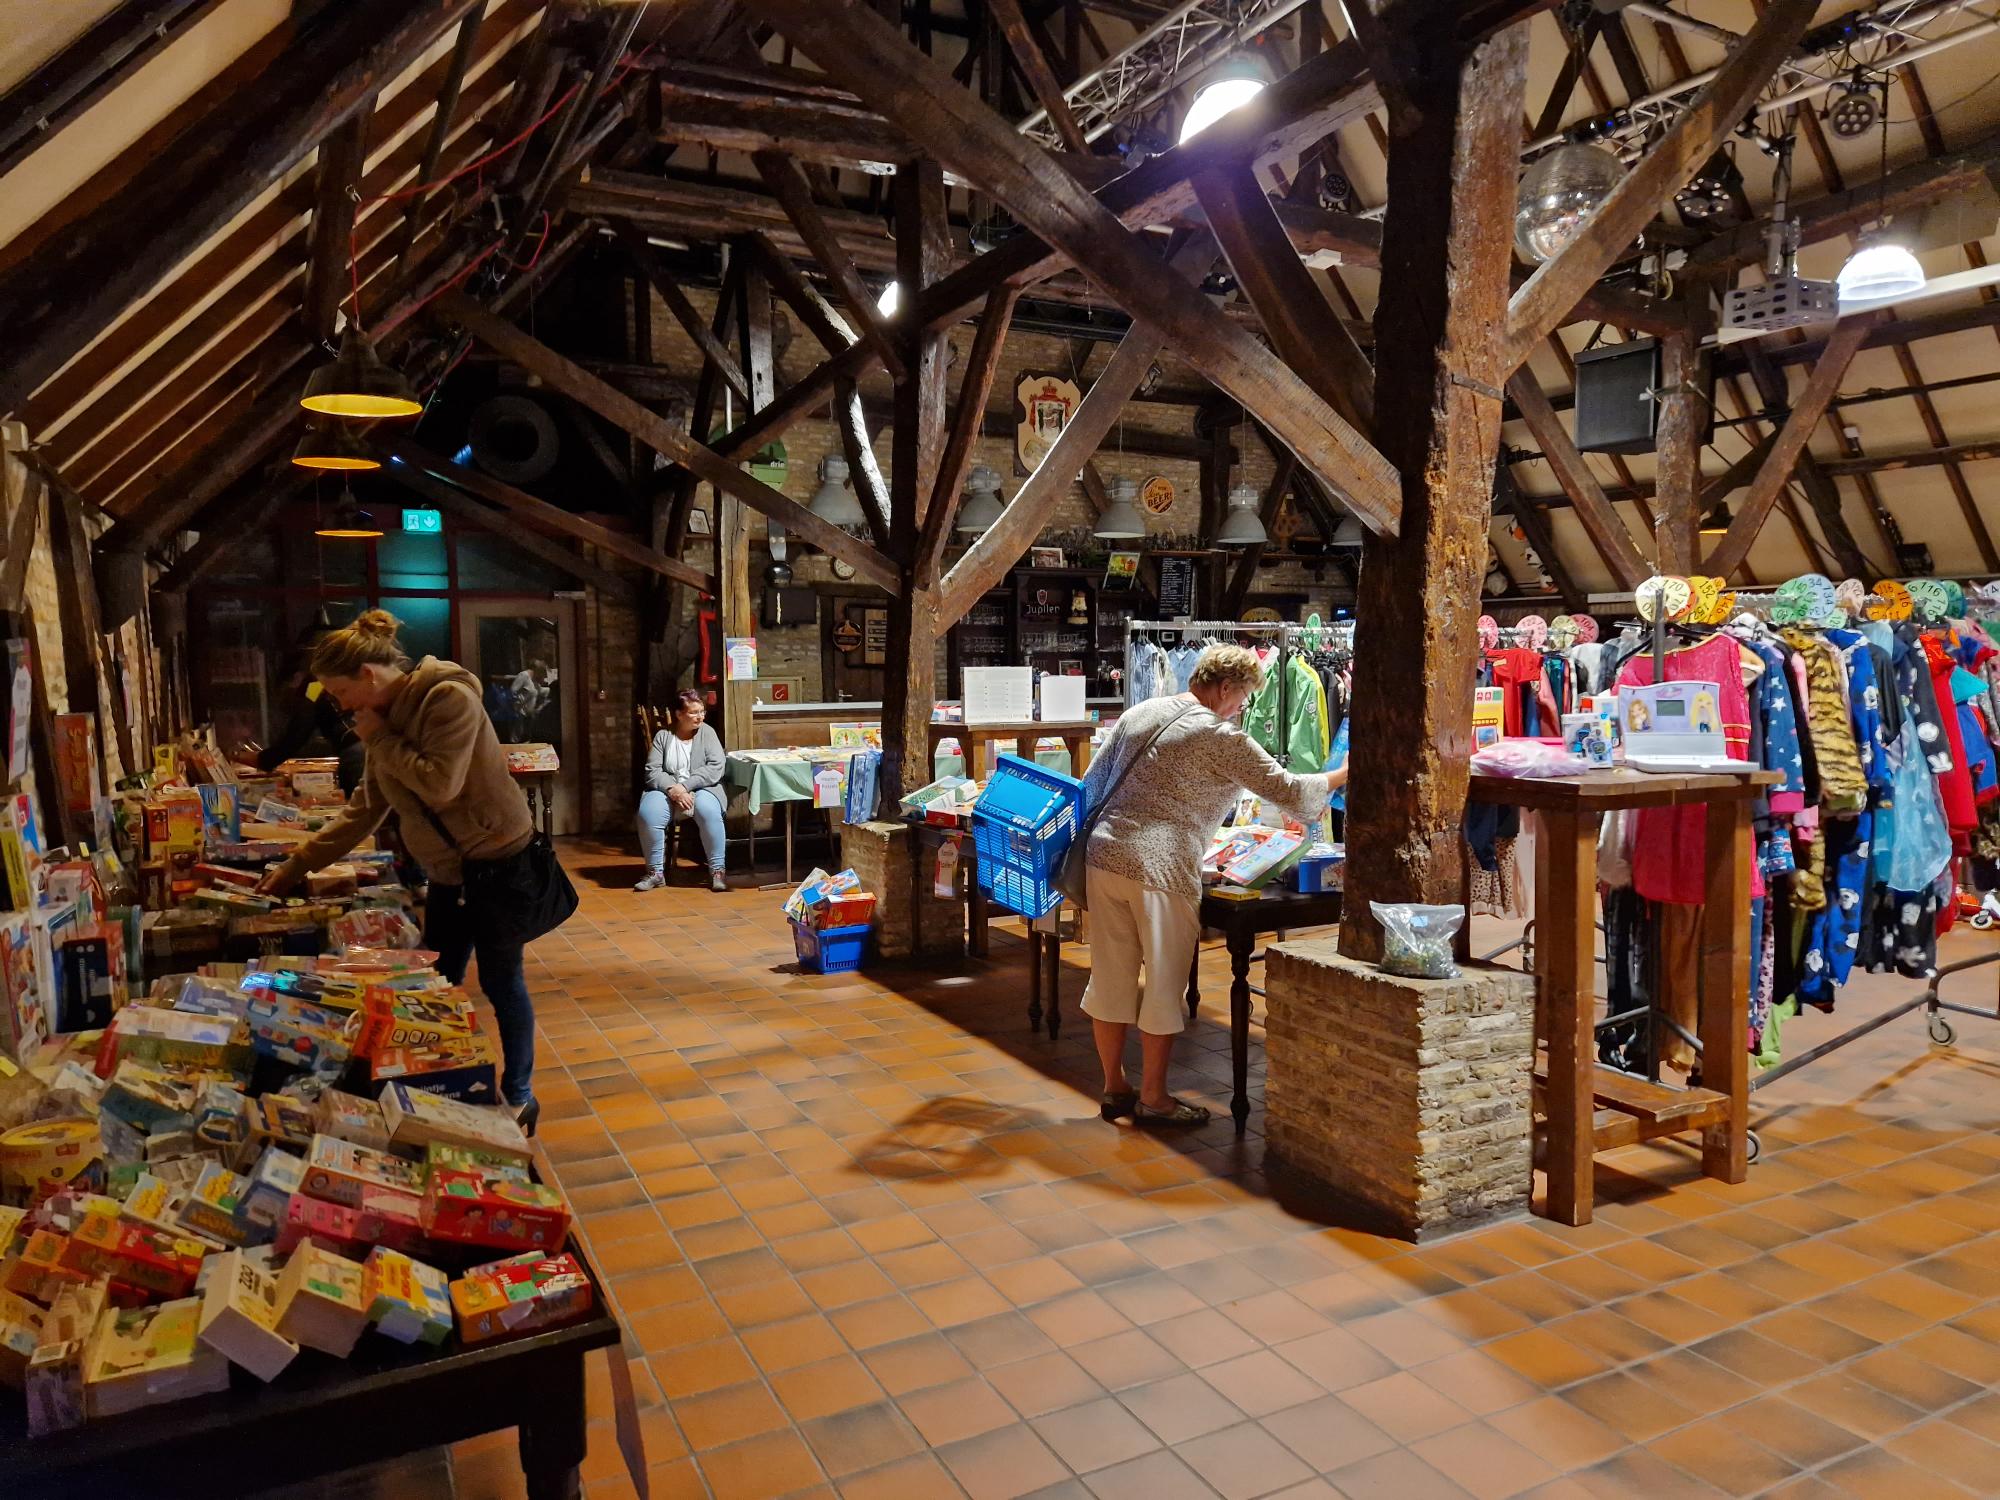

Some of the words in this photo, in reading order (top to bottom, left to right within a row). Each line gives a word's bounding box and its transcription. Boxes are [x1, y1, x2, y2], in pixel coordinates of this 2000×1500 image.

[1662, 579, 1684, 592] 170
[1699, 580, 1716, 599] 152
[1920, 580, 1941, 597] 116
[1823, 587, 1835, 605] 134
